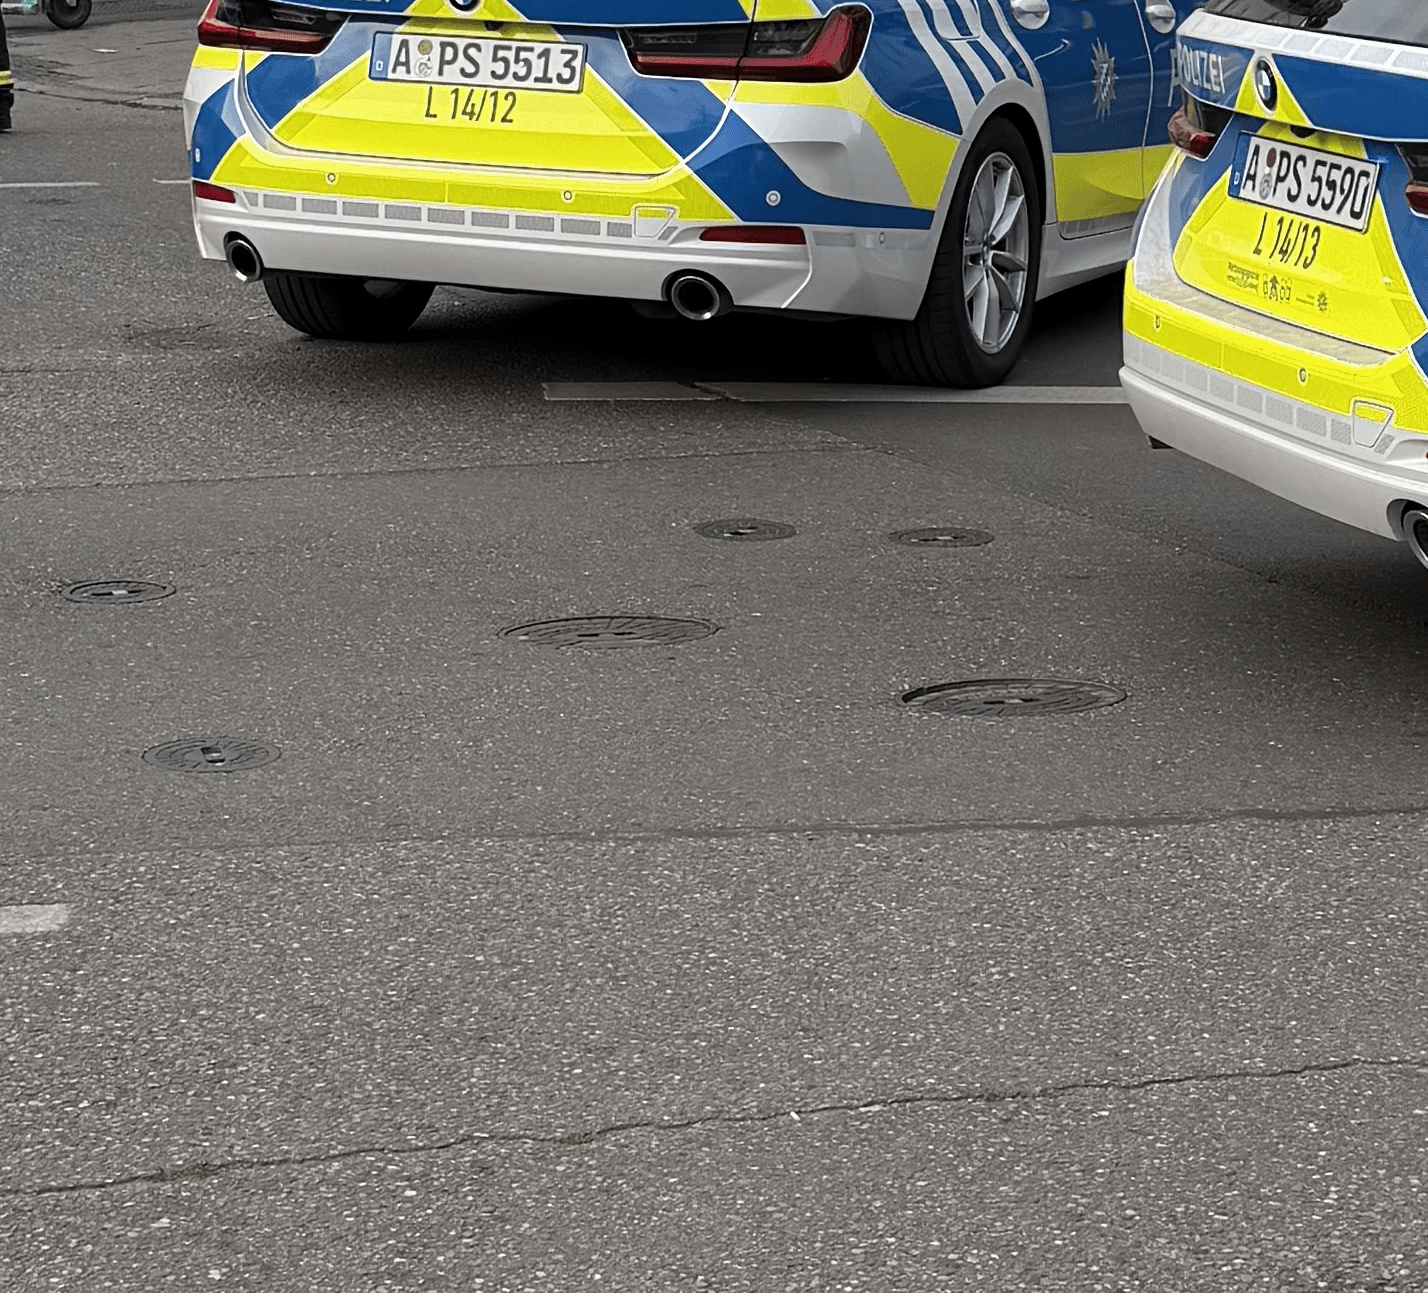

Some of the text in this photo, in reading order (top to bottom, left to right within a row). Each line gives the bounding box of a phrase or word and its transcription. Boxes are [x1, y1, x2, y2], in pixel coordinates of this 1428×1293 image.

[391, 38, 411, 76] A
[438, 41, 482, 81] PS
[490, 44, 579, 85] 5513
[425, 86, 518, 124] L 14/12
[1242, 144, 1261, 193] A
[1272, 150, 1307, 203] PS
[1307, 159, 1371, 221] 5590
[1253, 211, 1321, 270] L 14/13
